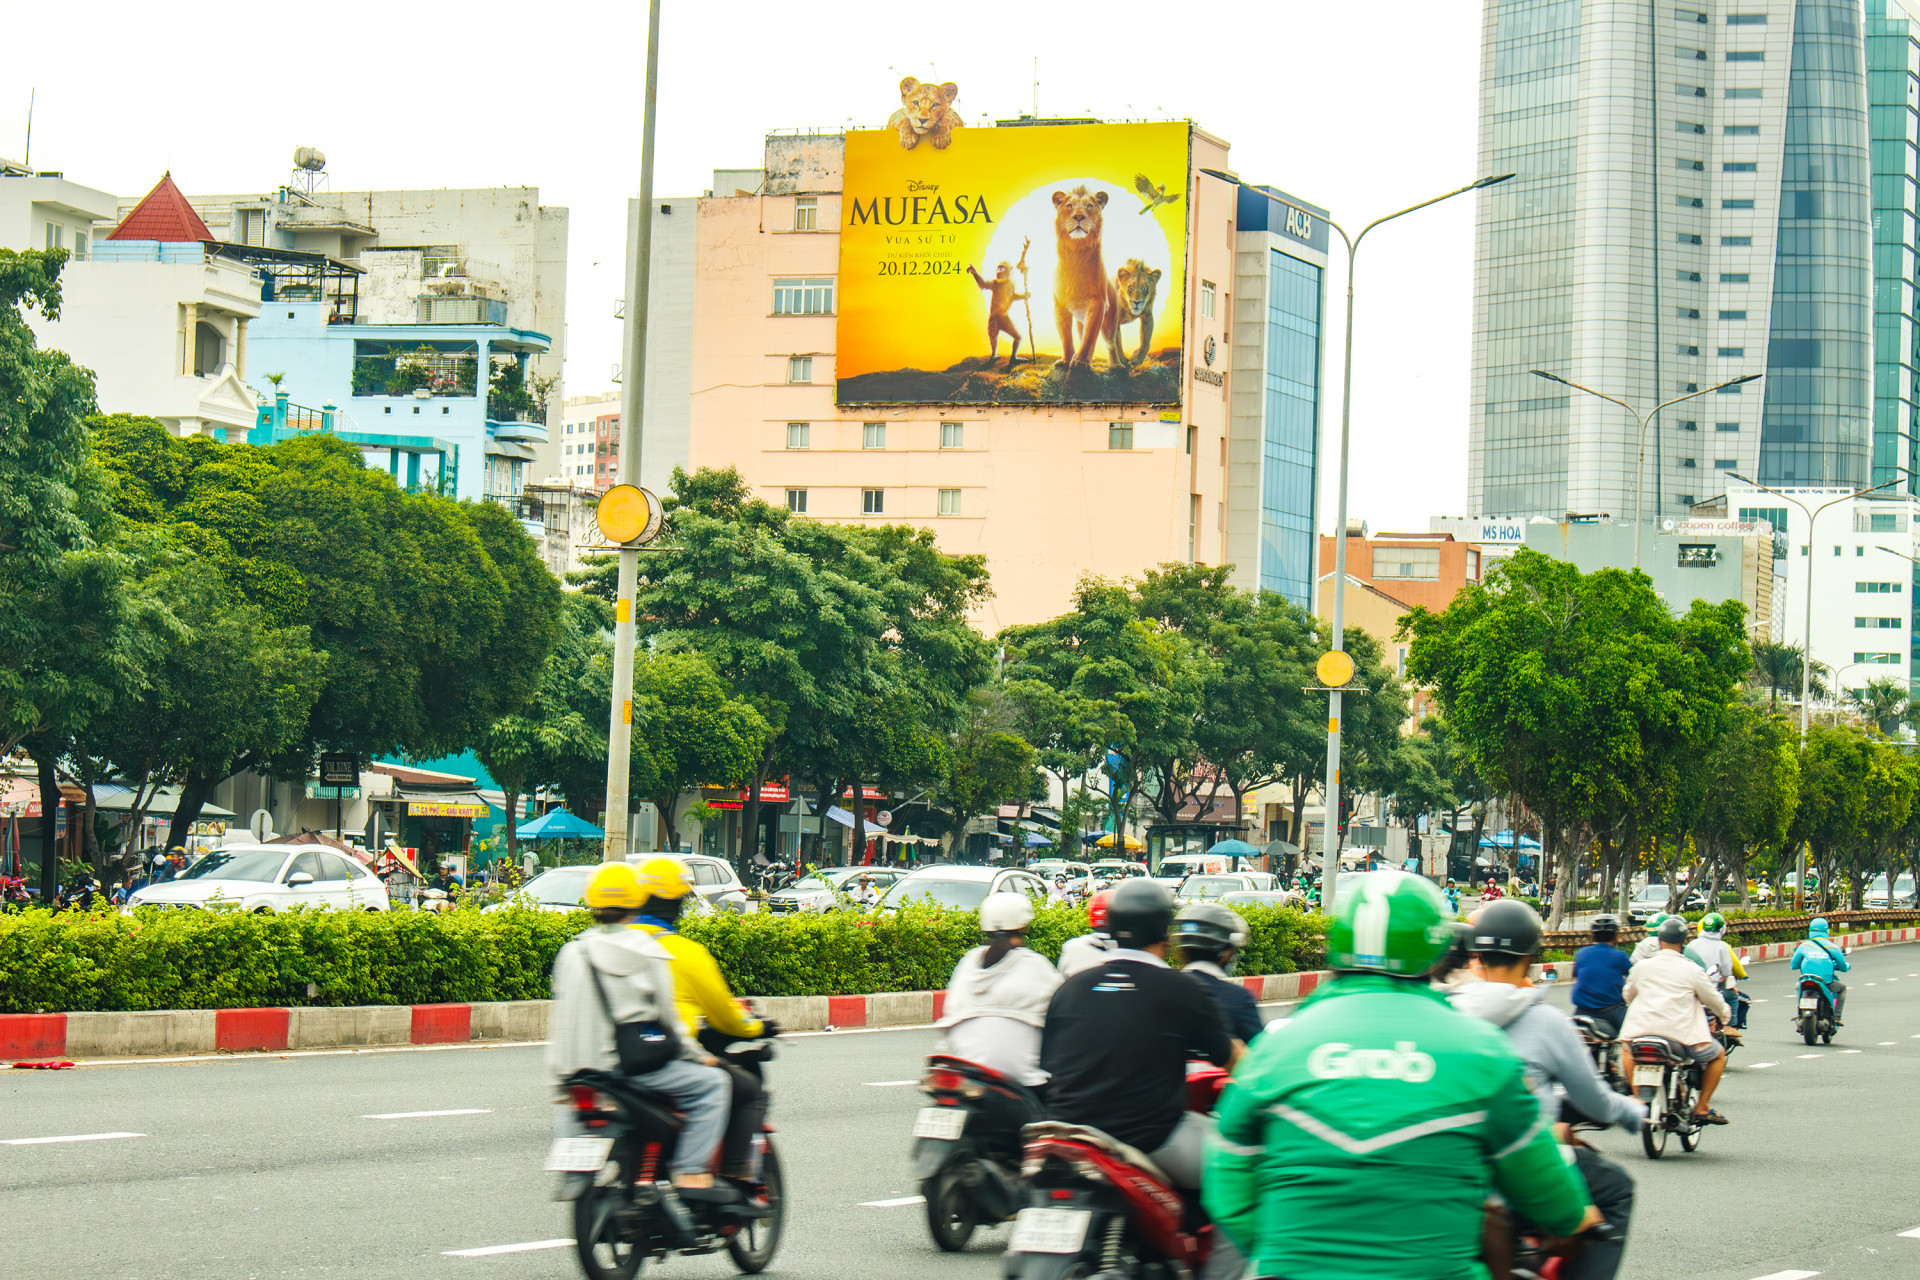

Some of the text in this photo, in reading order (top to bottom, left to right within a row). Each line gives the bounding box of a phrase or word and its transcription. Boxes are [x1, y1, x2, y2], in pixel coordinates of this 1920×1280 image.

[848, 194, 995, 226] MUFASA
[1285, 206, 1311, 240] ACB
[877, 260, 962, 276] 20.12.2024
[1483, 525, 1497, 540] MS
[1499, 525, 1522, 540] HOA
[1307, 1040, 1437, 1083] Grab
